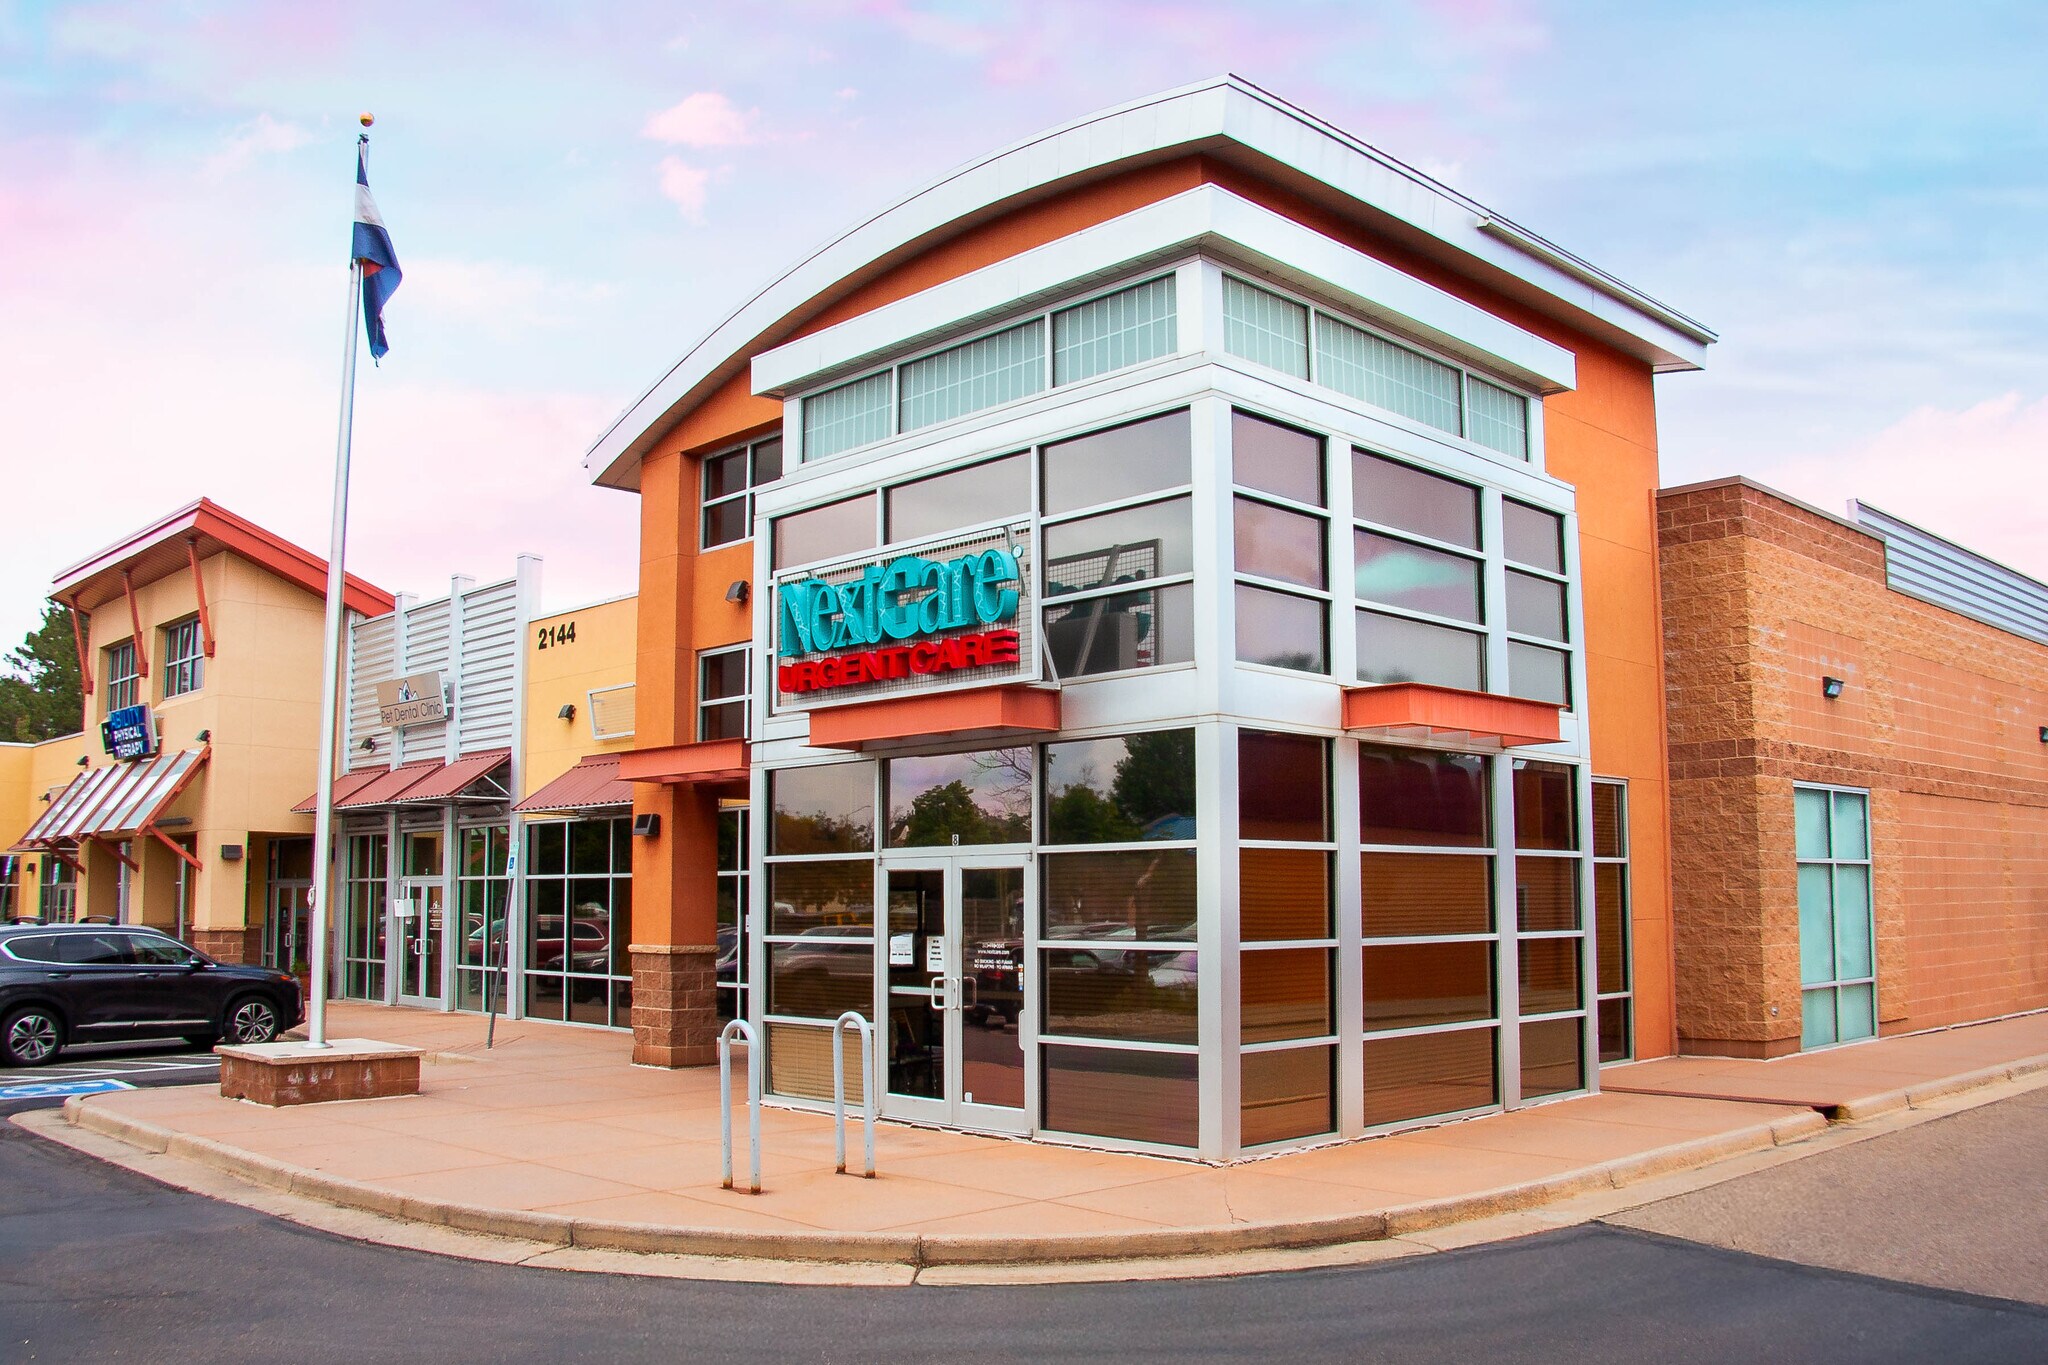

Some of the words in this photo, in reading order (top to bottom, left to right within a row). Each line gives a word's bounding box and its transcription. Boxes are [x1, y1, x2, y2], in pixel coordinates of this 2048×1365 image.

[779, 549, 1020, 657] NextCare
[538, 621, 576, 650] 2144
[778, 646, 911, 693] URGENT
[908, 629, 1020, 675] CARE
[111, 707, 140, 729] ABILITY
[381, 710, 393, 723] Pet
[394, 704, 419, 722] Dental
[420, 701, 442, 717] Clinic
[113, 725, 142, 742] PHYSICAL
[116, 741, 143, 758] THERAPY
